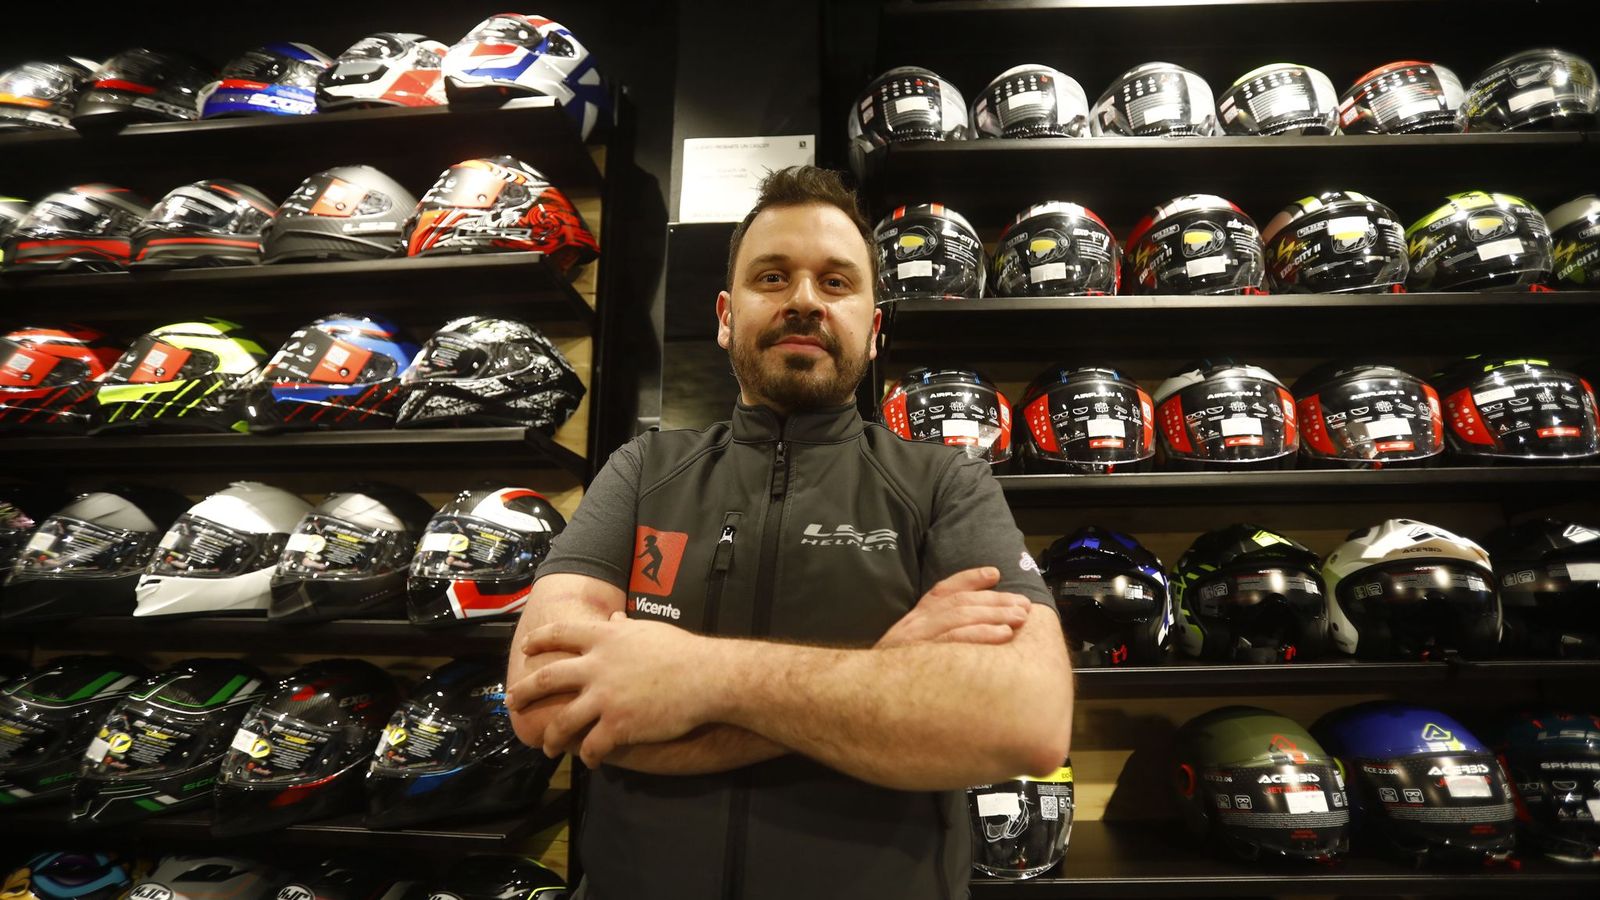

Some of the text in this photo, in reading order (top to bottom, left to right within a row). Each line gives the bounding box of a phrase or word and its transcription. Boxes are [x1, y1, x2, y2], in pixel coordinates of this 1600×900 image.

[1280, 247, 1314, 279] EXO-CITY
[1414, 240, 1448, 273] EXO-CITY
[1556, 249, 1599, 281] EXO-CITY
[1513, 382, 1558, 390] IRFLOW
[929, 391, 972, 399] AIRFLOW
[1073, 392, 1115, 400] AIRFLOW
[1207, 391, 1253, 400] AIRFLOW
[1350, 390, 1397, 400] AIRFLOW
[800, 537, 898, 552] HELMETS
[635, 596, 681, 620] Vicente
[131, 886, 170, 900] HJC
[279, 887, 309, 900] HJC
